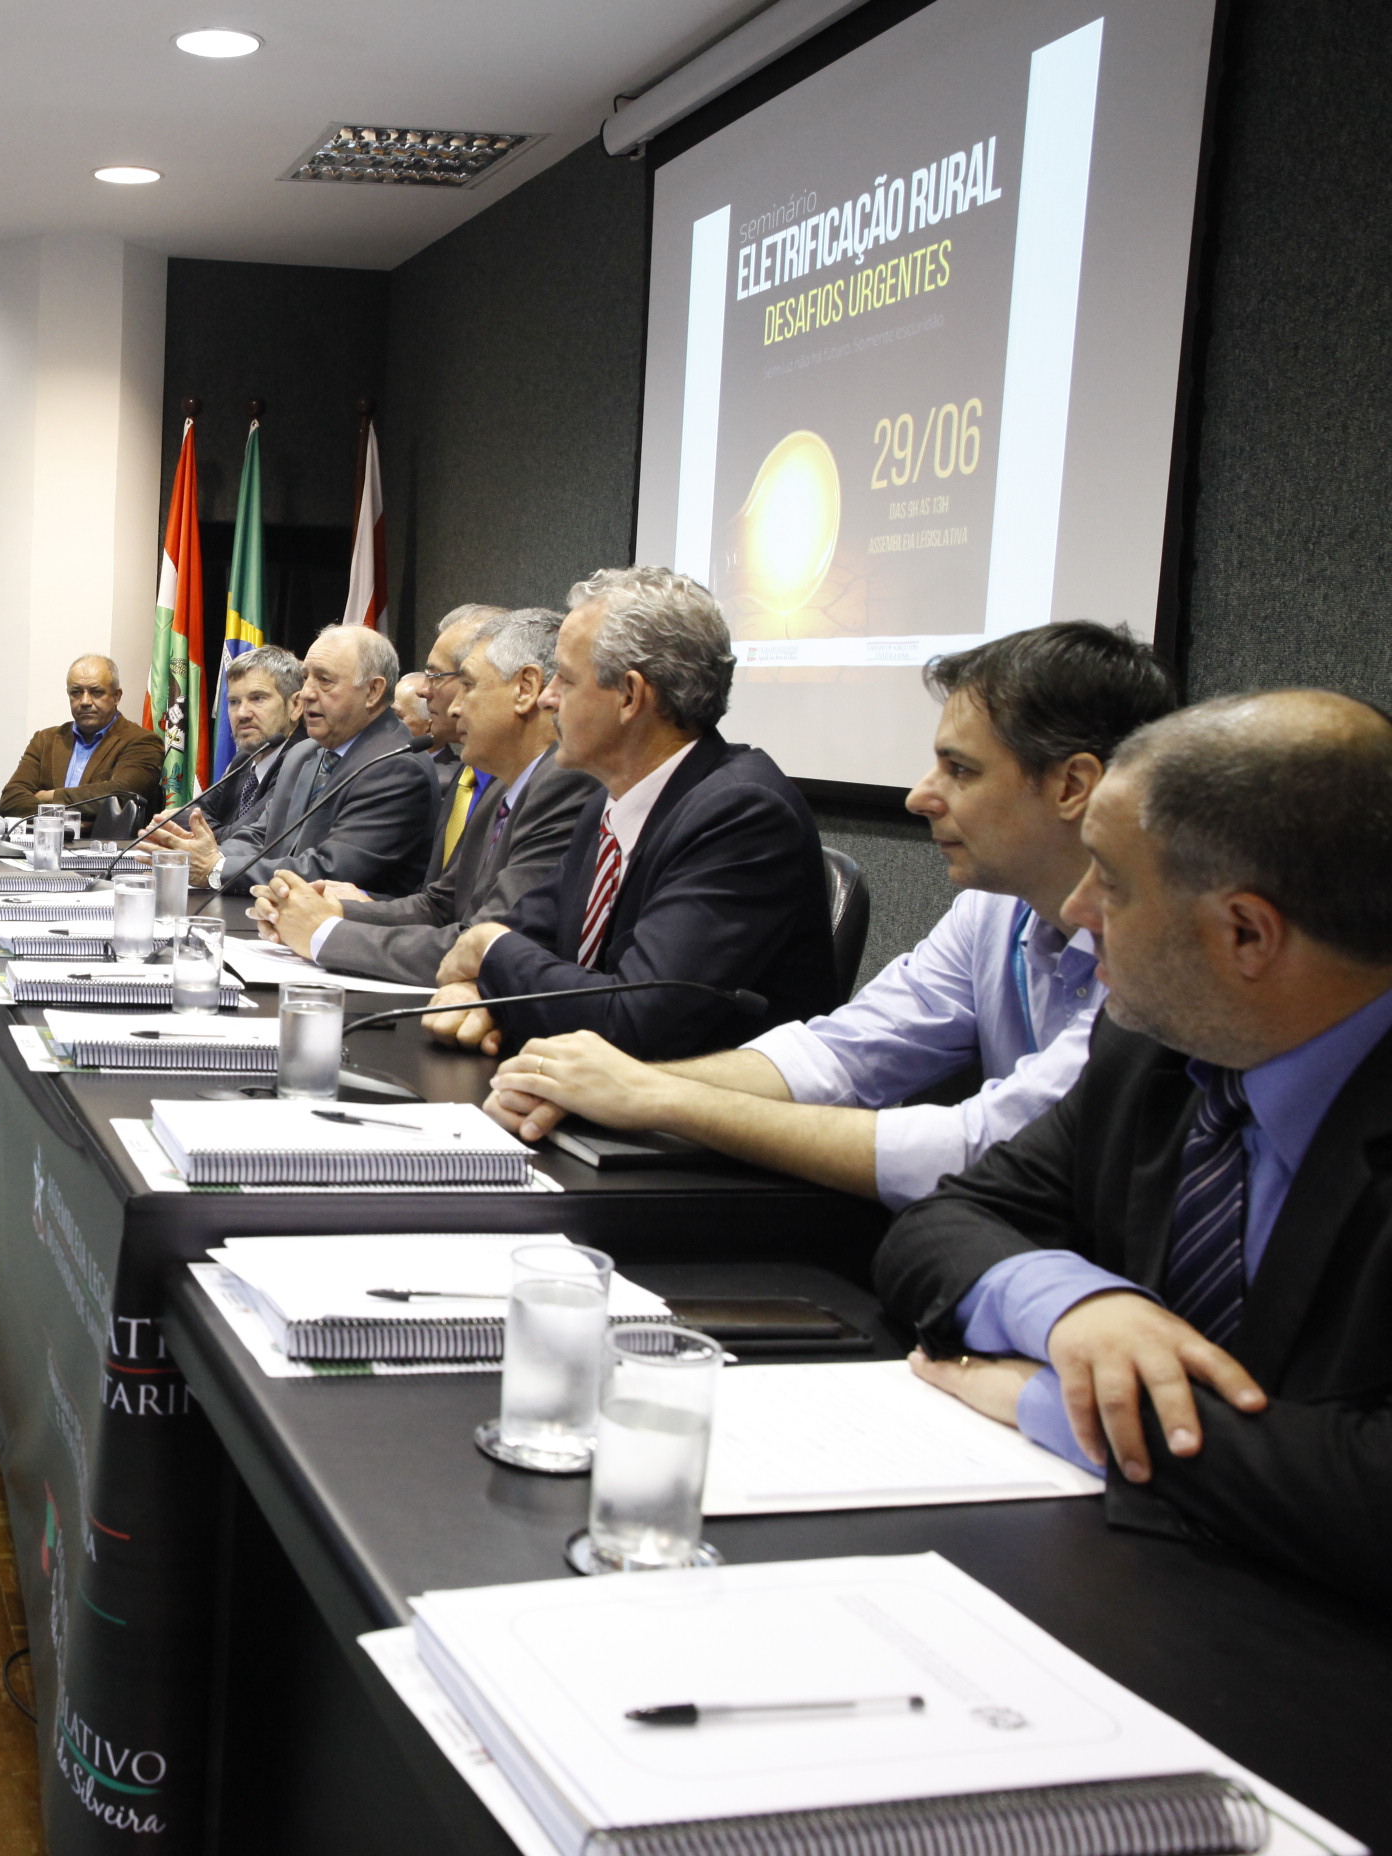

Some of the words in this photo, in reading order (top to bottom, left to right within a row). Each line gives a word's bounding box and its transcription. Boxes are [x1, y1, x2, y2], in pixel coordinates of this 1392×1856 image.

[736, 173, 906, 302] ELETRIFICAÇÃO
[908, 135, 1002, 234] RURAL
[739, 188, 818, 244] seminário
[763, 279, 845, 346] DESAFIOS
[848, 239, 952, 318] URGENTES
[870, 397, 983, 490] 29/06
[916, 526, 968, 549] LEGISLATIVA
[72, 1762, 166, 1835] Silveira
